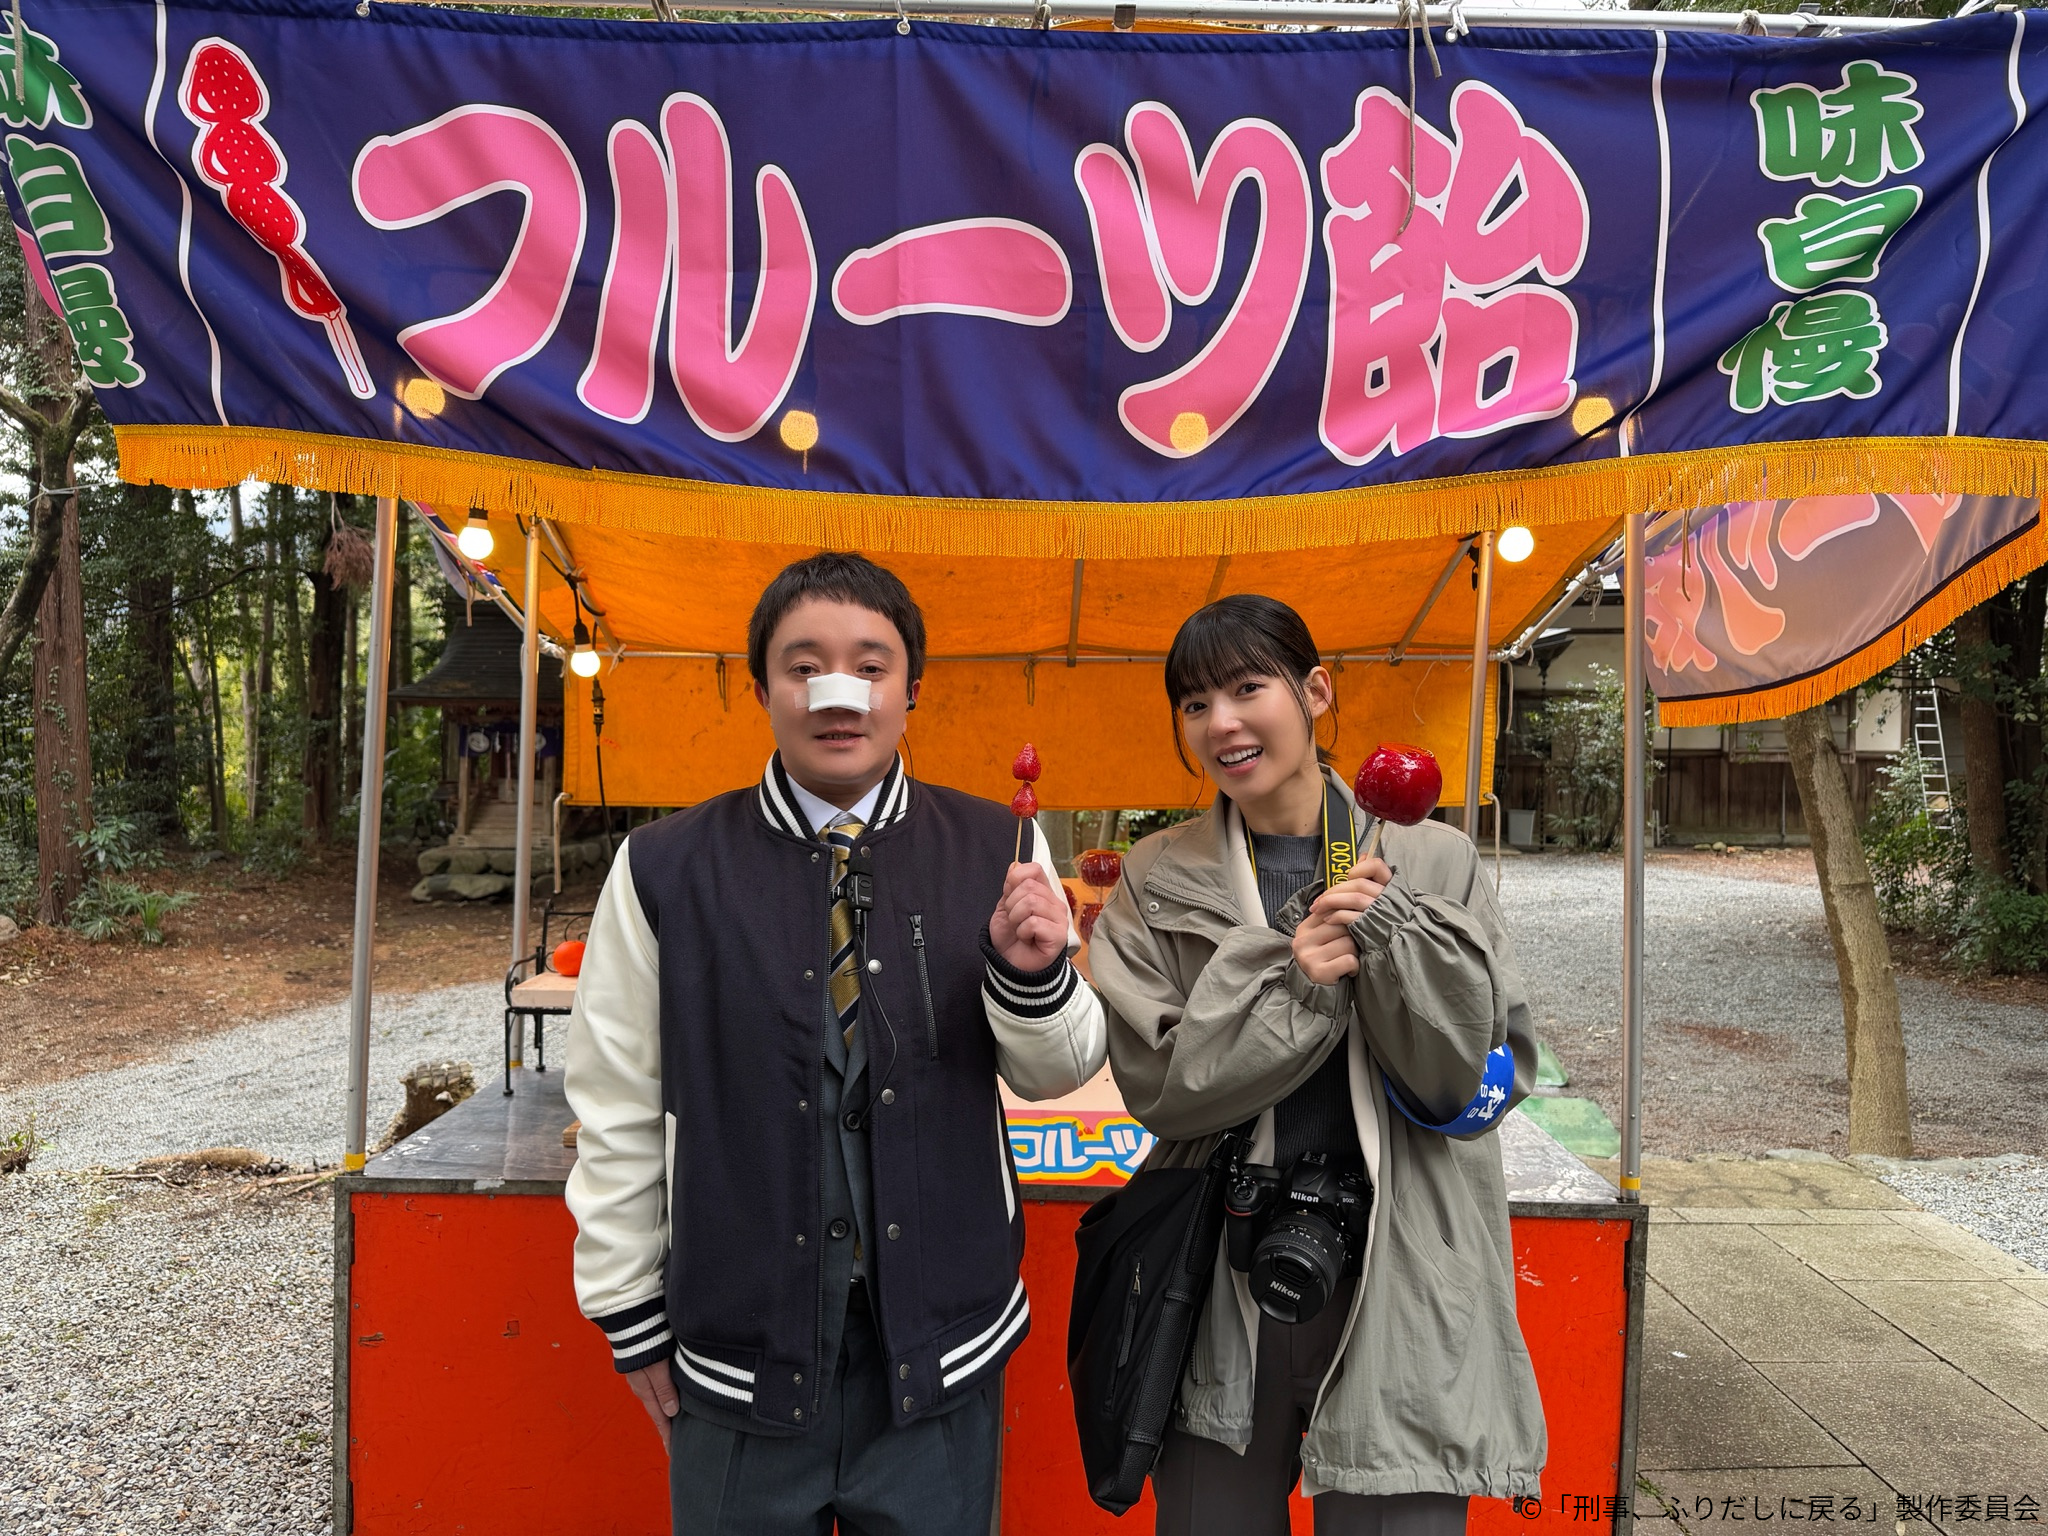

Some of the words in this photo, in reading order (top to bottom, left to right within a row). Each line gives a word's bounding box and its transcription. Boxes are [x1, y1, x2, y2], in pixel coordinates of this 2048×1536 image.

[1717, 60, 1924, 414] 味自慢
[352, 78, 1590, 465] フルーツ飴
[1008, 1128, 1153, 1168] フルーツ
[1290, 1191, 1320, 1203] Nikon
[1270, 1280, 1301, 1301] Nikon
